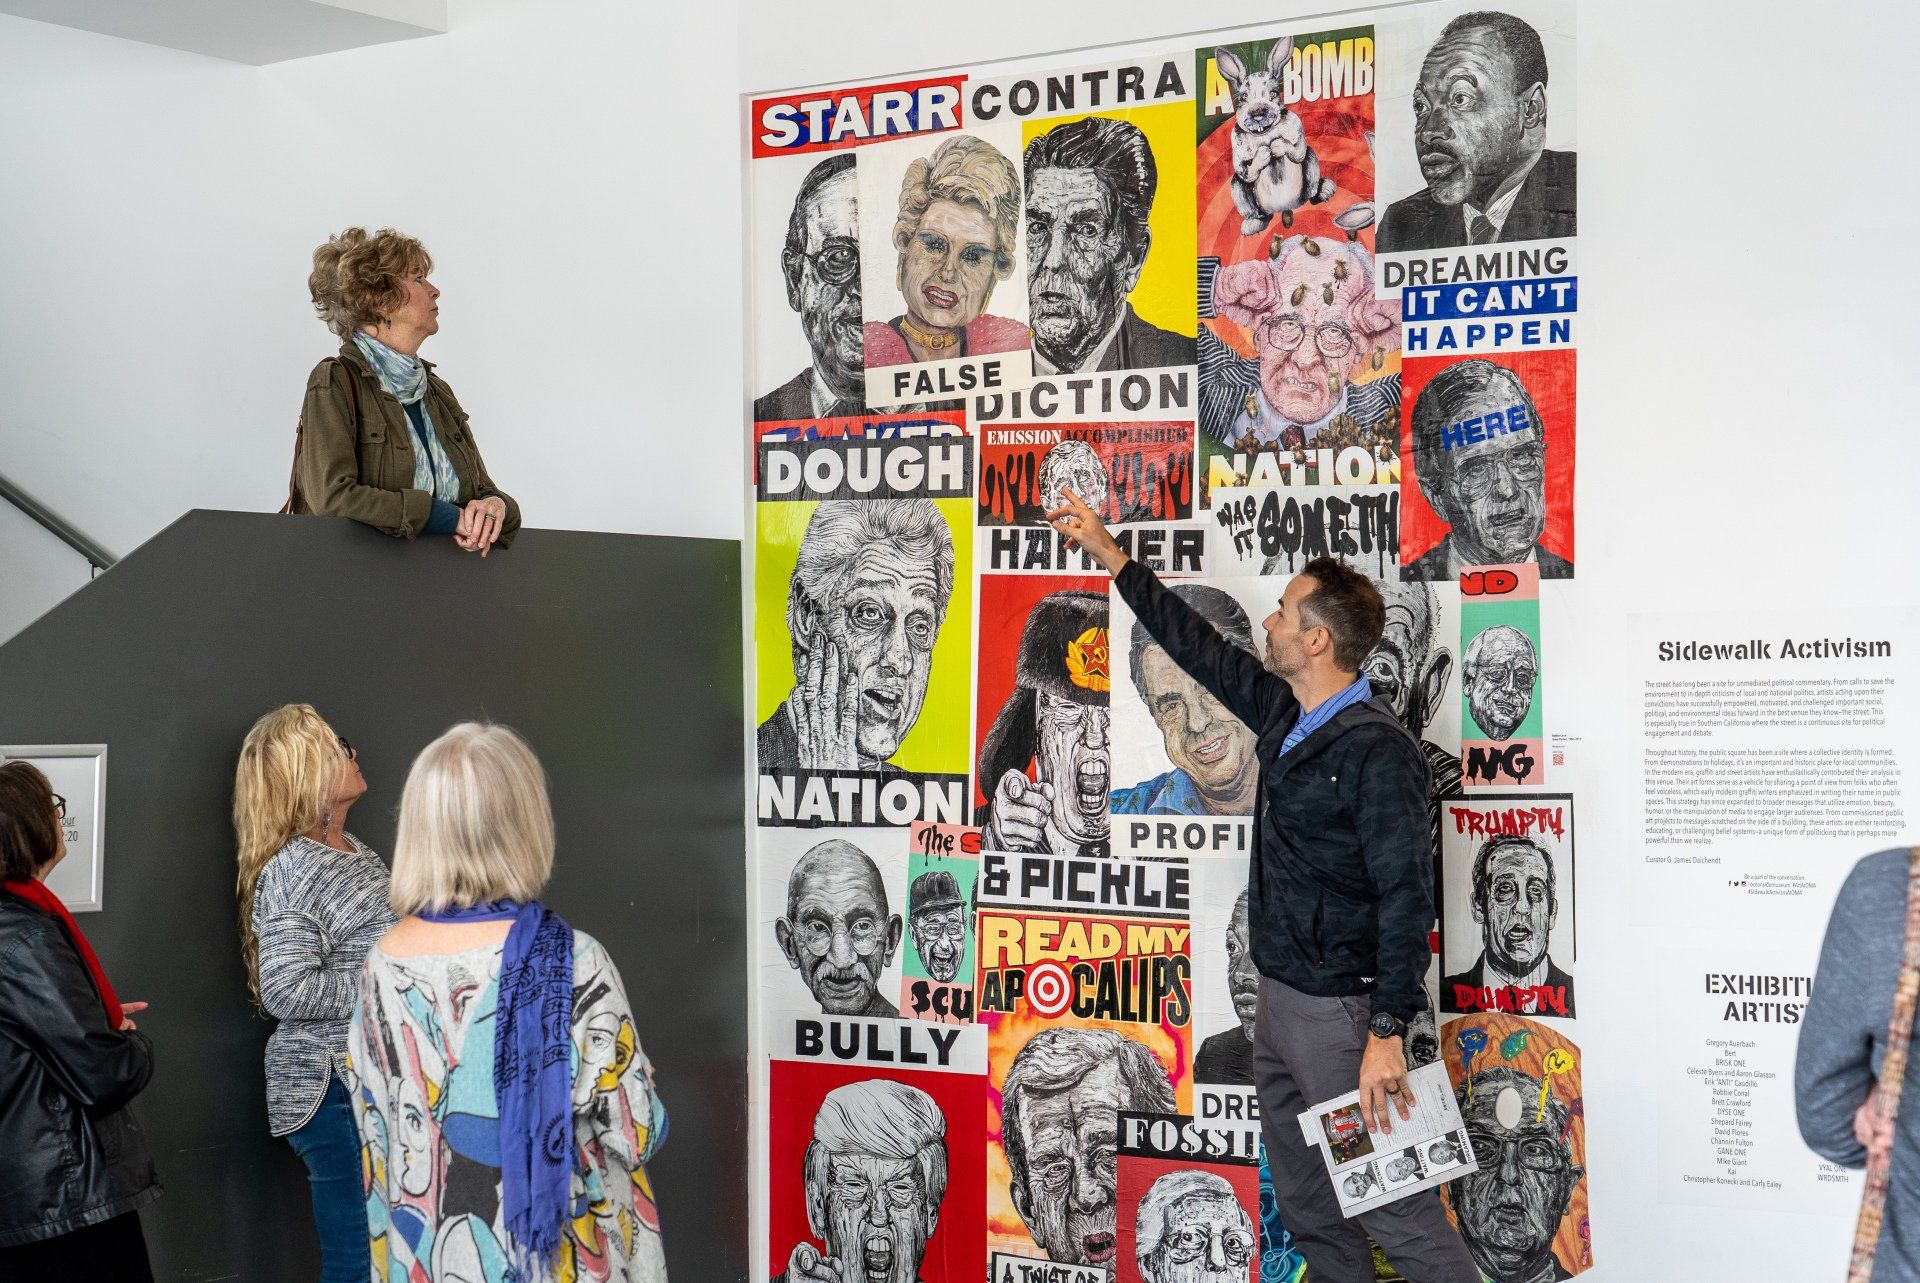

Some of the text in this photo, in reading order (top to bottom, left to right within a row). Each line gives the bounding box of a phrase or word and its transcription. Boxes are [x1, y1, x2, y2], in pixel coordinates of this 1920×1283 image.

[1283, 37, 1375, 104] BOMB
[972, 61, 1187, 120] CONTRA
[760, 85, 960, 147] STARR
[1384, 246, 1569, 289] DREAMING
[1408, 282, 1571, 316] IT CAN'T
[1408, 319, 1571, 351] HAPPEN
[894, 361, 1002, 398] FALSE
[976, 372, 1189, 421] DICTION
[986, 429, 1063, 446] EMISSION
[1440, 405, 1530, 452] HERE
[767, 444, 963, 494] DOUGH
[1208, 445, 1400, 491] NATION
[1658, 637, 1892, 662] Sidewalk Activism
[1683, 681, 1696, 690] long
[1772, 680, 1794, 689] political
[1835, 689, 1853, 698] acting
[1690, 700, 1722, 709] successfully
[1803, 699, 1834, 708] challenged
[1836, 699, 1864, 708] important
[1809, 709, 1822, 718] they
[1645, 730, 1680, 738] engagement
[1650, 720, 1677, 729] especially
[1862, 719, 1885, 728] political
[759, 774, 963, 826] NATION
[62, 830, 78, 842] :20
[1130, 822, 1245, 850] PROFI
[1449, 806, 1565, 842] TRUMPTY
[984, 856, 1190, 911] & PICKLE
[981, 917, 1190, 968] READ MY
[1453, 982, 1569, 1015] DUMPTY
[795, 1019, 961, 1066] BULLY
[1706, 1040, 1755, 1049] Gregory Auerbach
[1707, 1069, 1723, 1079] Byers
[1734, 1080, 1757, 1088] Caudillo
[1726, 1099, 1751, 1108] Crawford
[1711, 1119, 1752, 1130] Shepard Fairey
[1711, 1138, 1735, 1146] Channin
[1684, 1175, 1715, 1186] Christopher
[1751, 1180, 1766, 1190] Carly
